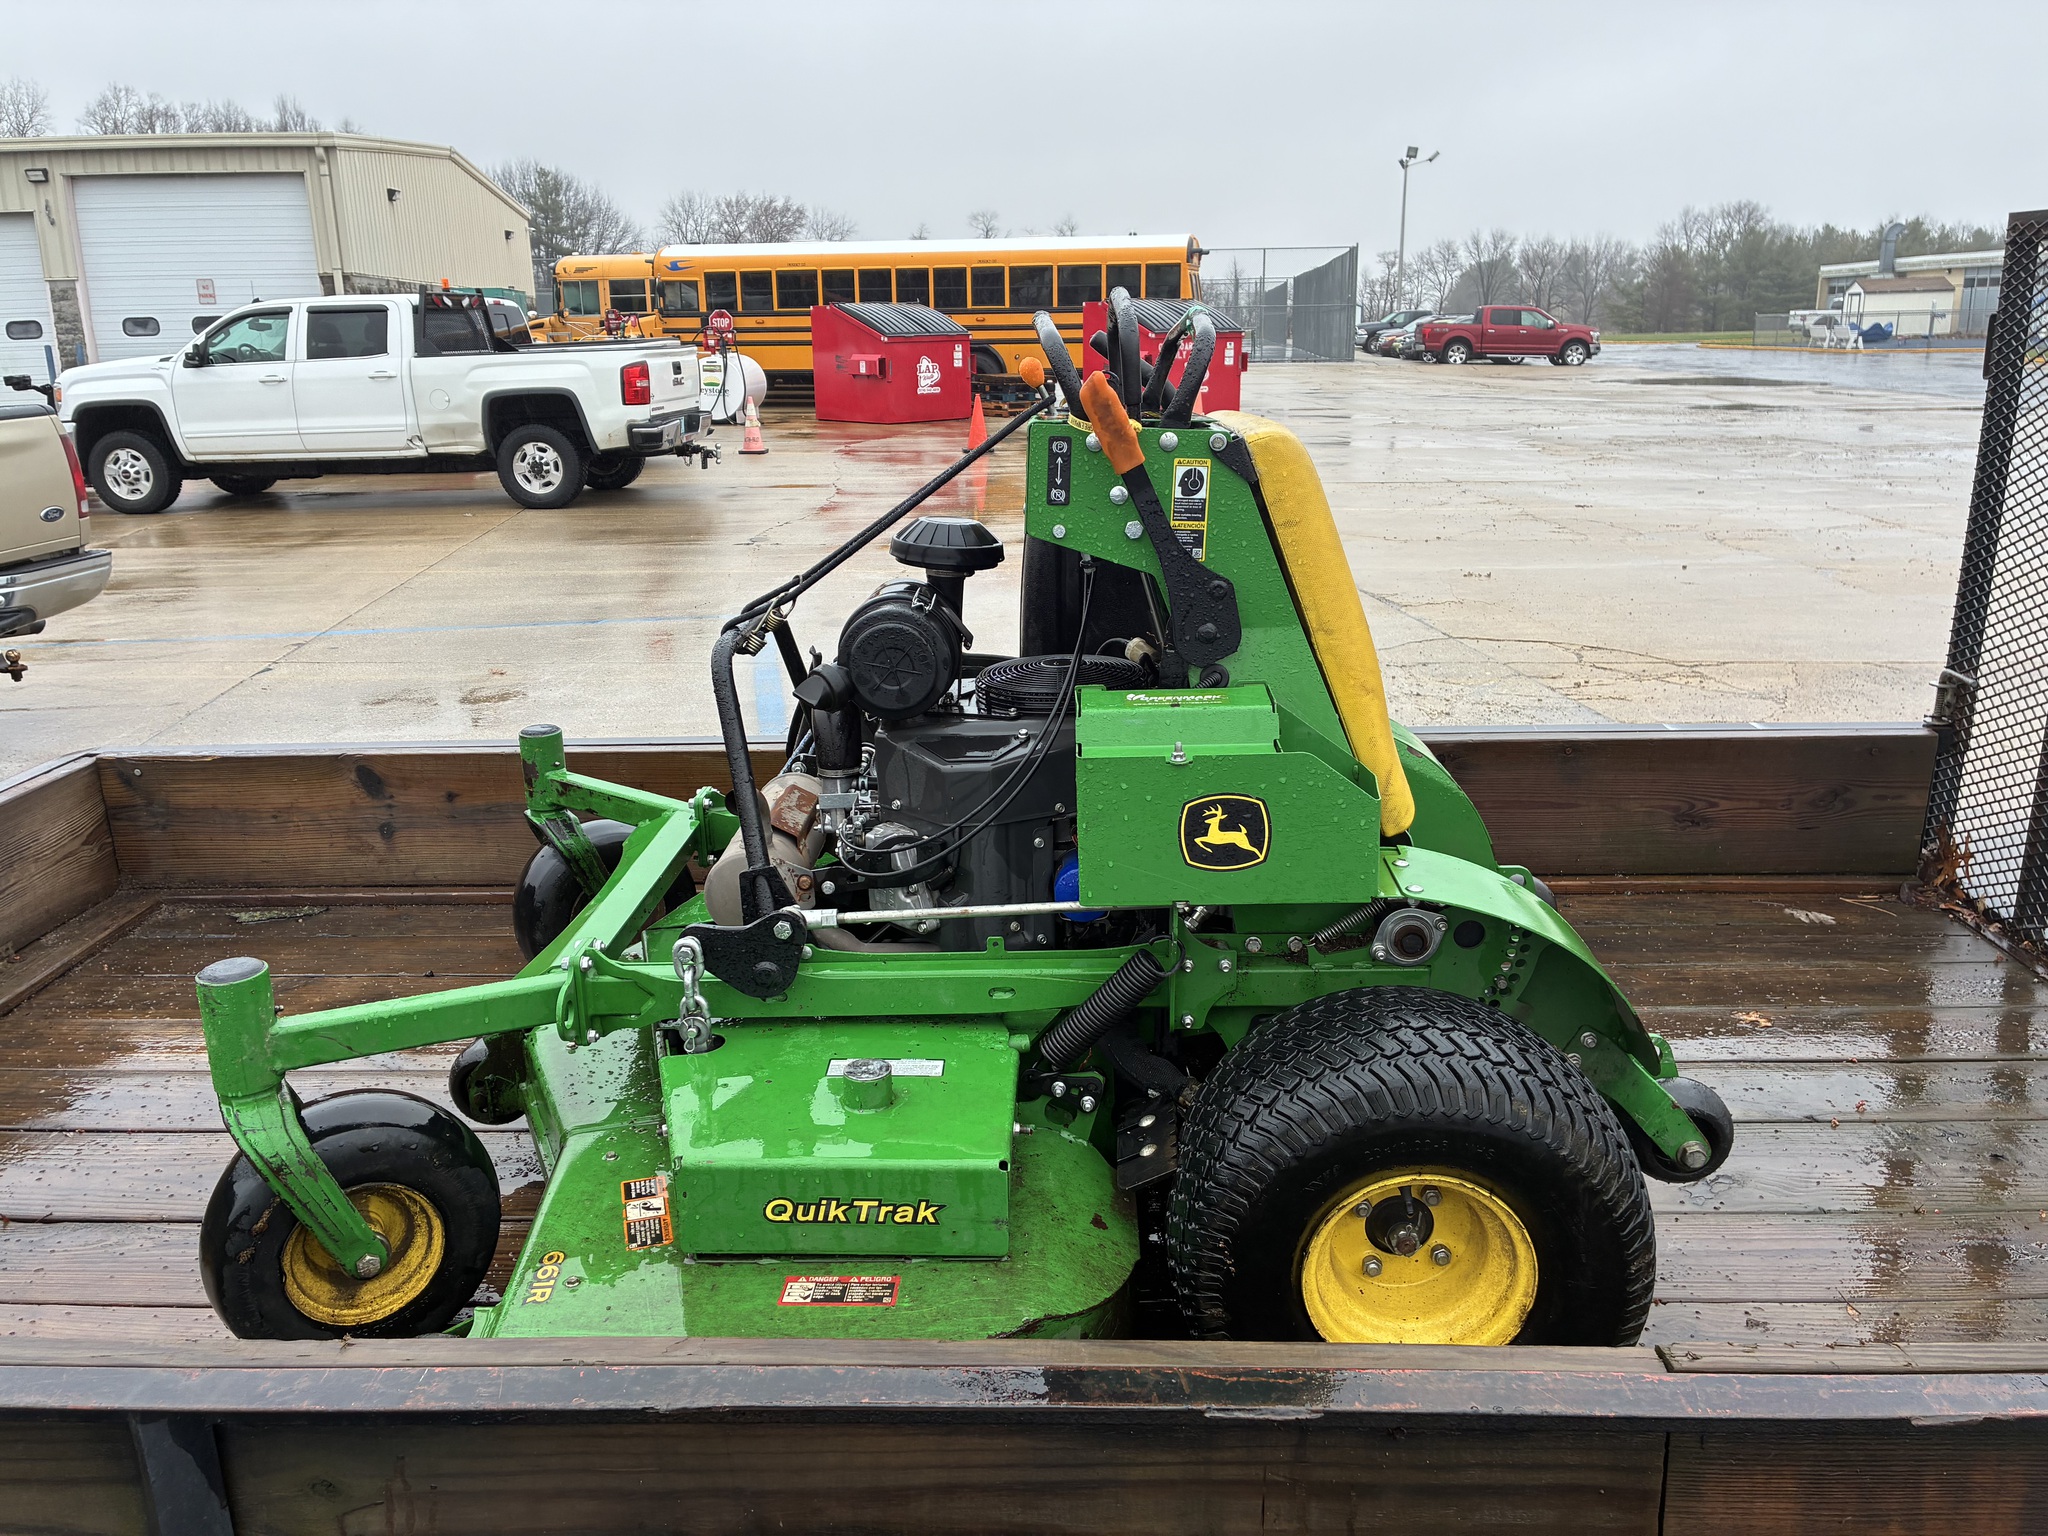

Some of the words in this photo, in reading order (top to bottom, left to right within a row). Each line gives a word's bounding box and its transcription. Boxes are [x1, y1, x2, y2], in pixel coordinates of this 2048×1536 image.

[712, 317, 730, 328] STOP
[918, 364, 938, 374] LAP
[764, 1198, 940, 1224] QuikTrak
[525, 1250, 566, 1303] 661R
